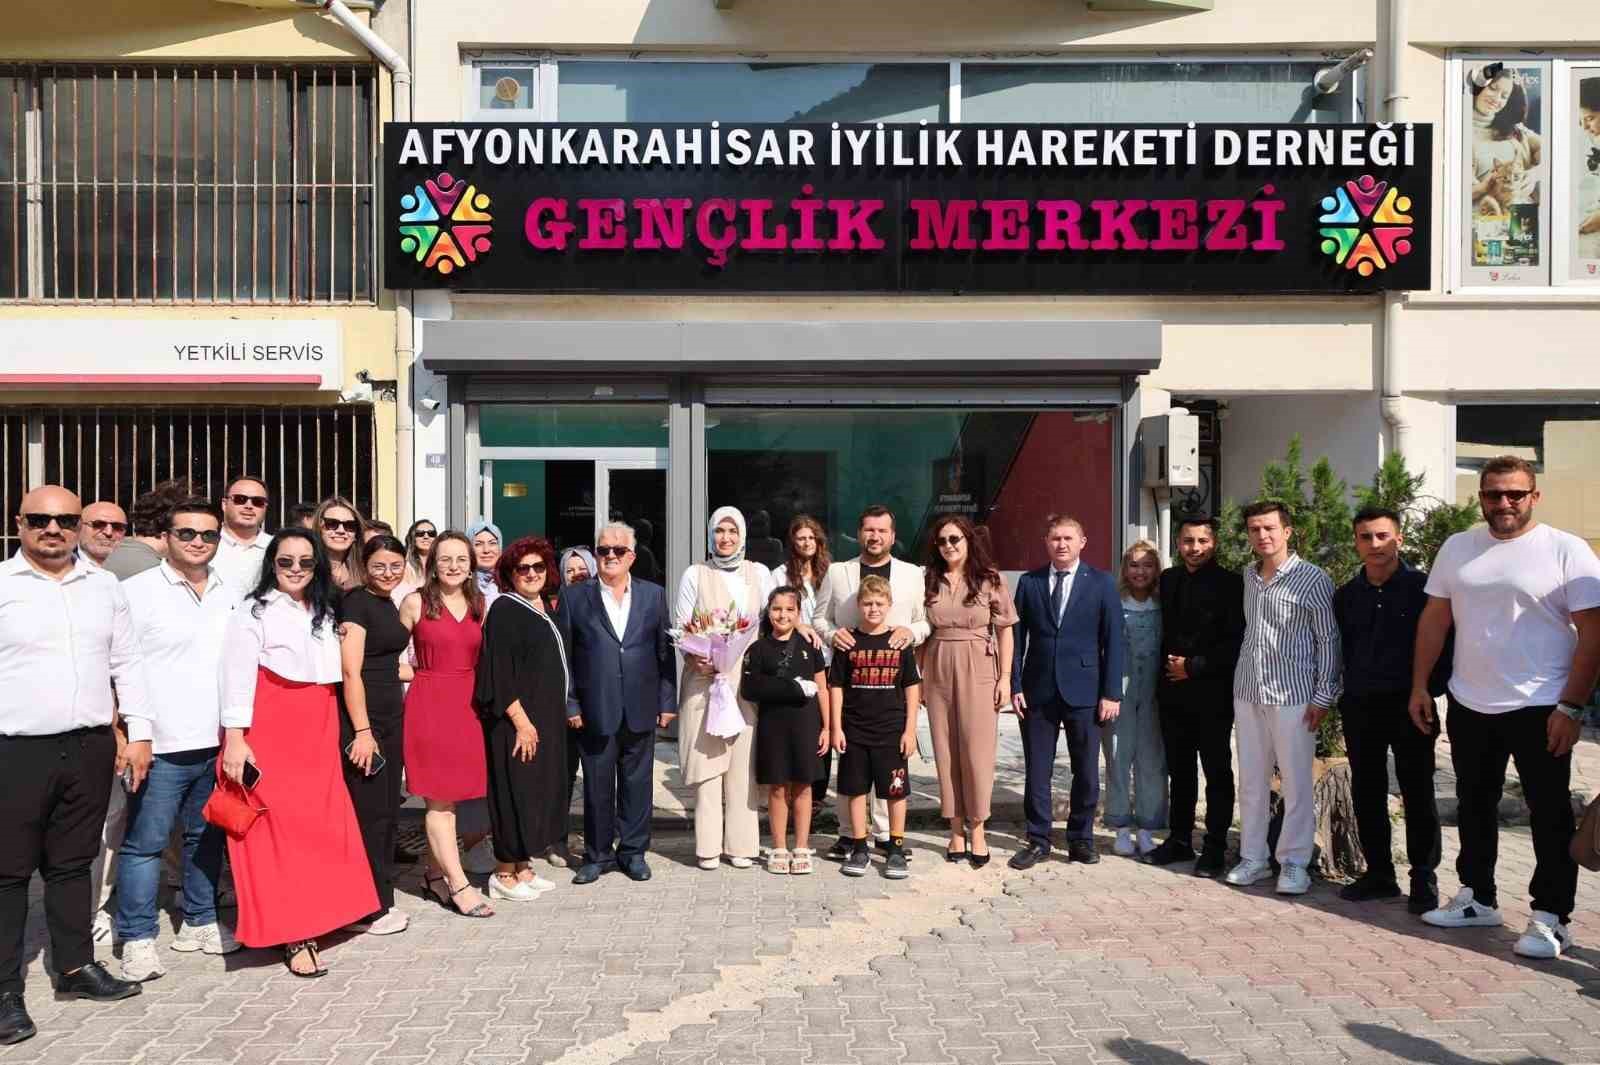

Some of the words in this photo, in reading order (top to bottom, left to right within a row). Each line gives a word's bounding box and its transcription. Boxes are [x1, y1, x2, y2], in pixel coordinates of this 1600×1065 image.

[398, 121, 816, 166] AFYONKARAHİSAR
[831, 121, 963, 166] İYİLİK
[977, 121, 1197, 166] HAREKETİ
[1214, 122, 1415, 166] DERNEĞİ
[524, 184, 885, 268] GENÇLİK
[910, 184, 1286, 251] MERKEZİ
[173, 342, 246, 361] YETKİLİ
[252, 342, 324, 361] SERVİS
